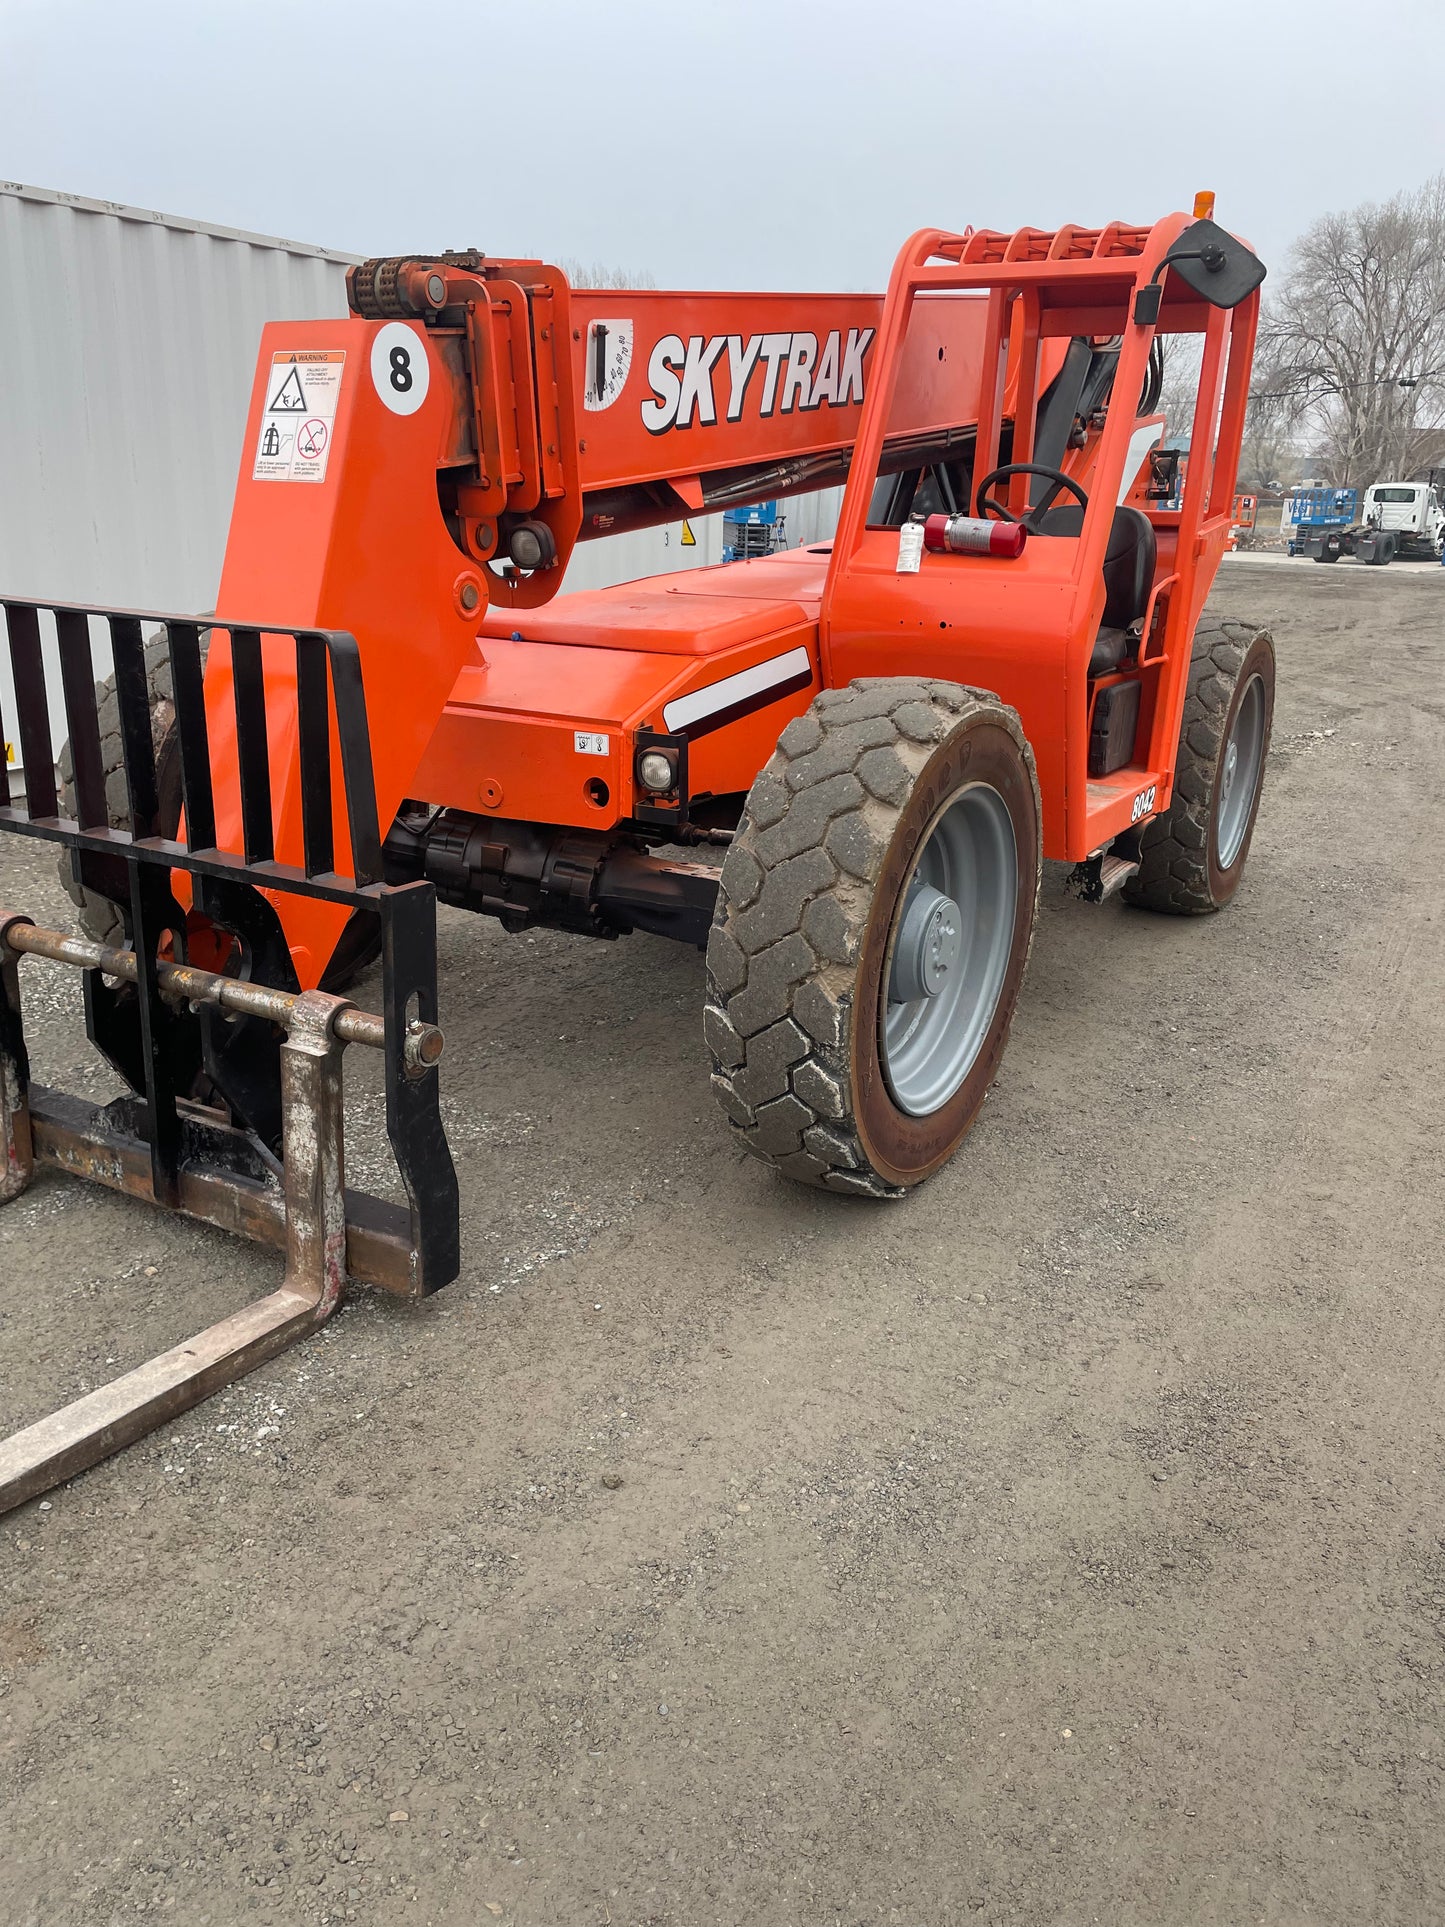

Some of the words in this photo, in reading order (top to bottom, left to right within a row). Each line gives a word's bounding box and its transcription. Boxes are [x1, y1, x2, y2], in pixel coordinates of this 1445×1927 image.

[389, 346, 413, 393] 8
[640, 328, 877, 436] SKYTRAK
[1131, 784, 1156, 823] 8042
